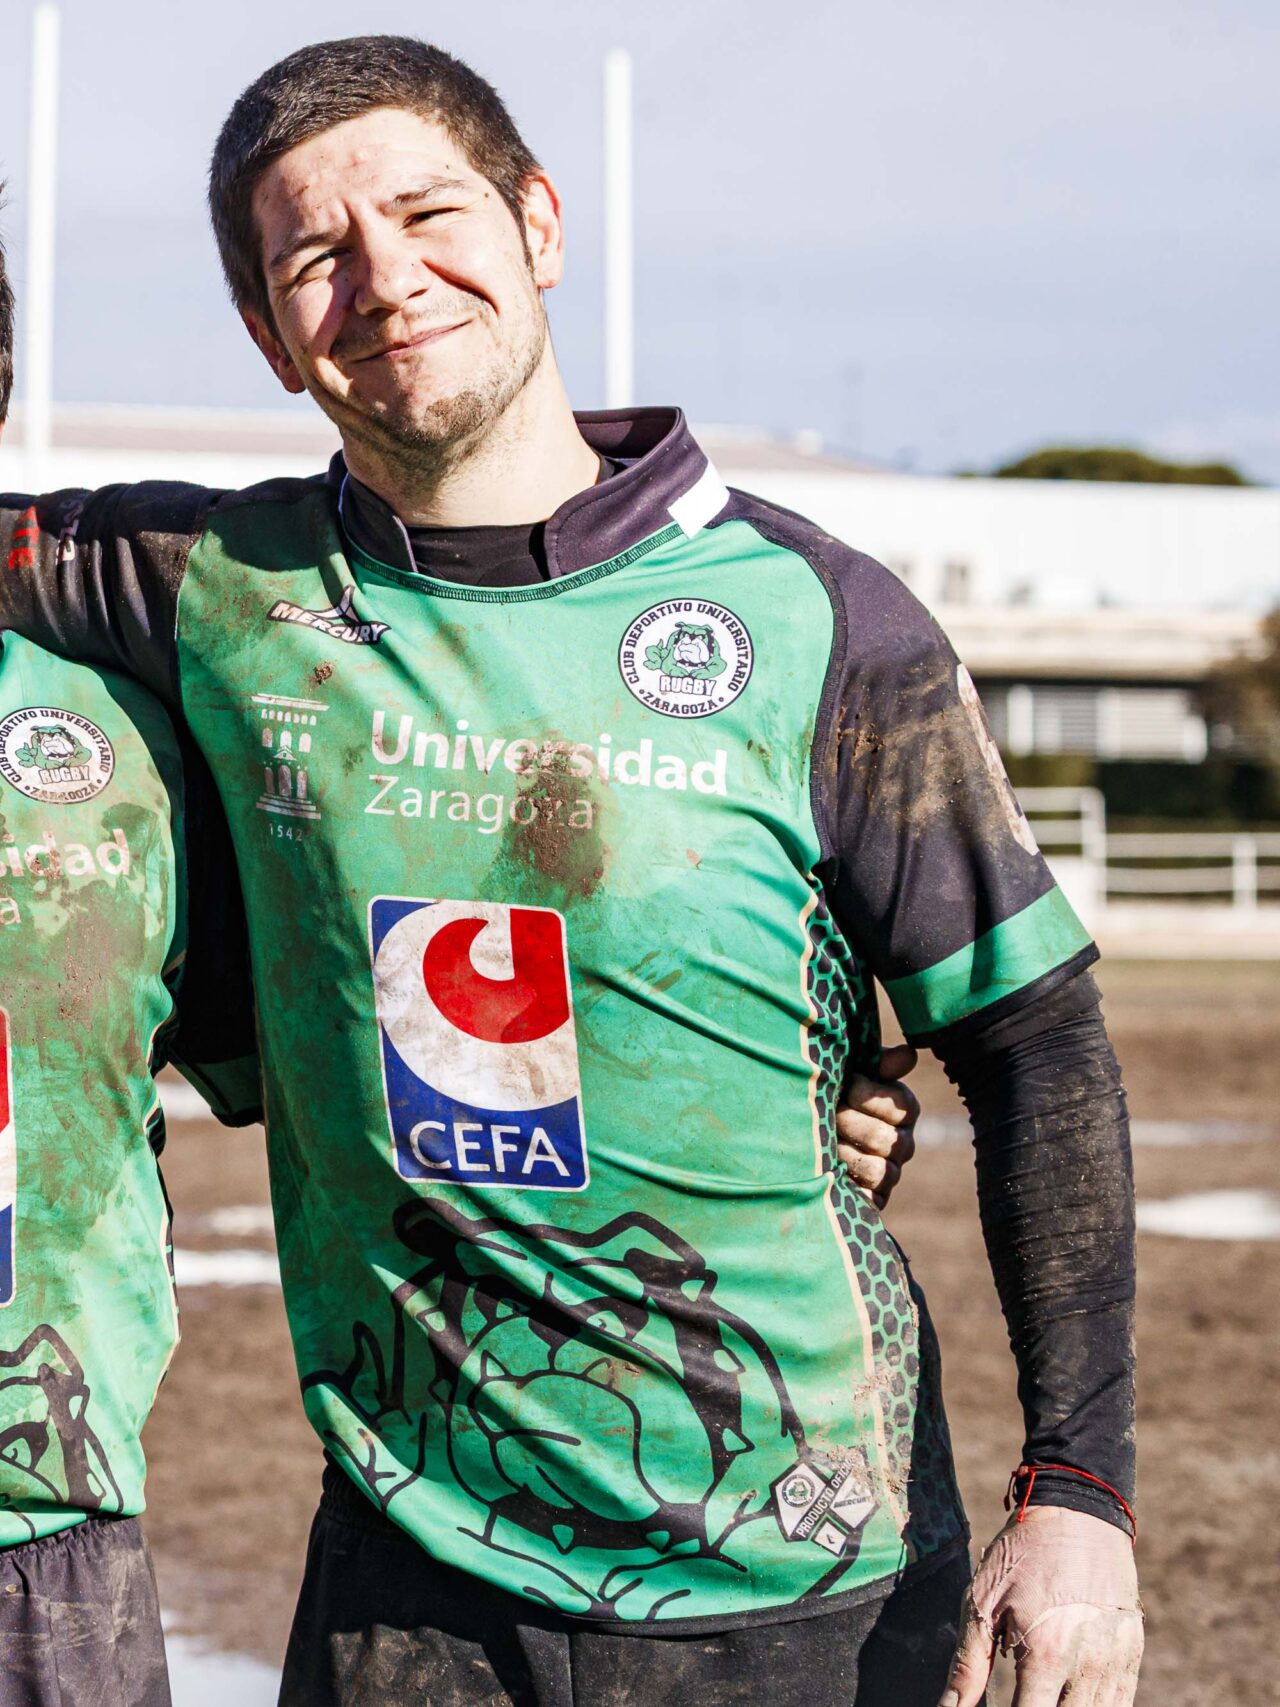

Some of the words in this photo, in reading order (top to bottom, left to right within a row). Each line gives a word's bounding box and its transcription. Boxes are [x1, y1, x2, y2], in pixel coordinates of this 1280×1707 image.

[270, 601, 389, 642] MERCURY
[625, 602, 692, 649] DEPORTIVO
[623, 651, 640, 684] CLUB
[696, 603, 749, 692] UNIVERSITARIO
[642, 691, 718, 715] ZARAGOZA
[659, 675, 717, 696] RUGBY
[40, 709, 111, 774] UNIVERSITARIO
[371, 710, 728, 796] Universidad
[38, 765, 90, 785] RUGBY
[364, 774, 593, 835] Zaragoa
[269, 822, 303, 841] 1542
[409, 1120, 571, 1177] CEFA
[795, 1488, 835, 1538] PRODUCTO
